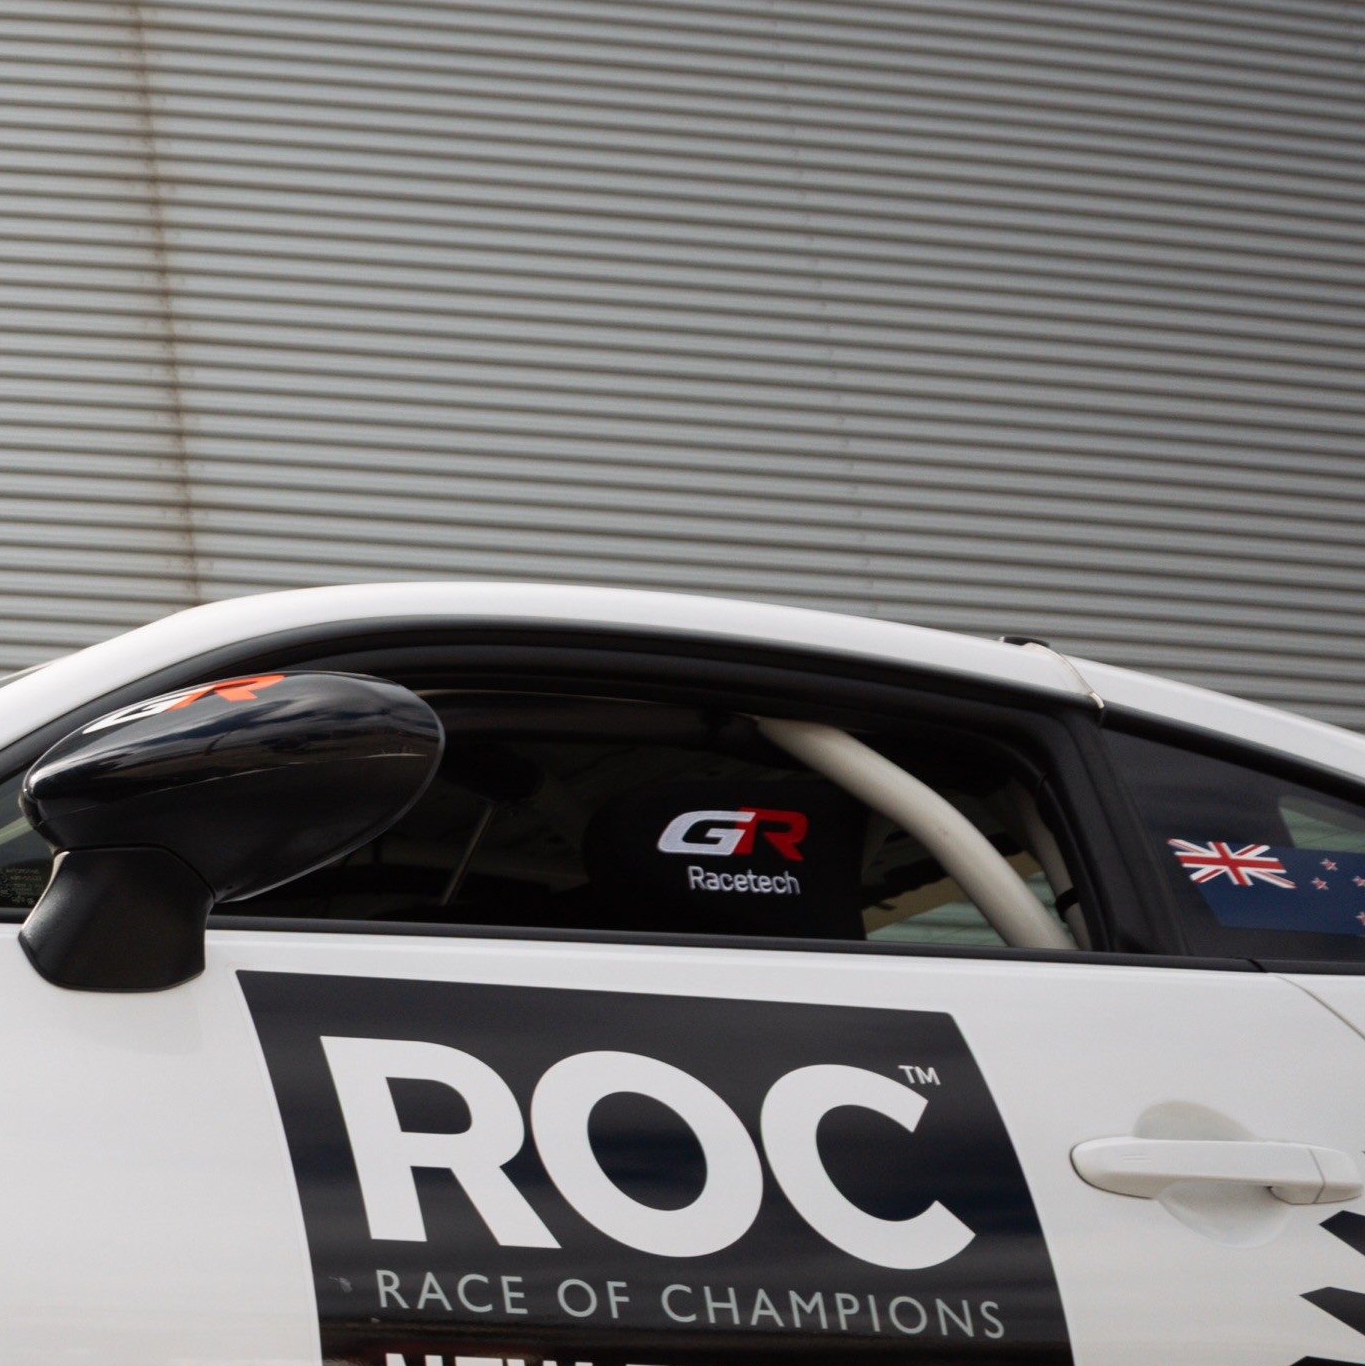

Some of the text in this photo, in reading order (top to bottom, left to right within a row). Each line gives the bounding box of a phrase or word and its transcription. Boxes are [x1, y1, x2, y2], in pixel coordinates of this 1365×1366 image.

[657, 806, 809, 862] GR
[687, 865, 802, 895] Racetech
[320, 1035, 977, 1270] ROC
[376, 1269, 1006, 1340] RACE OF CHAMPIONS
